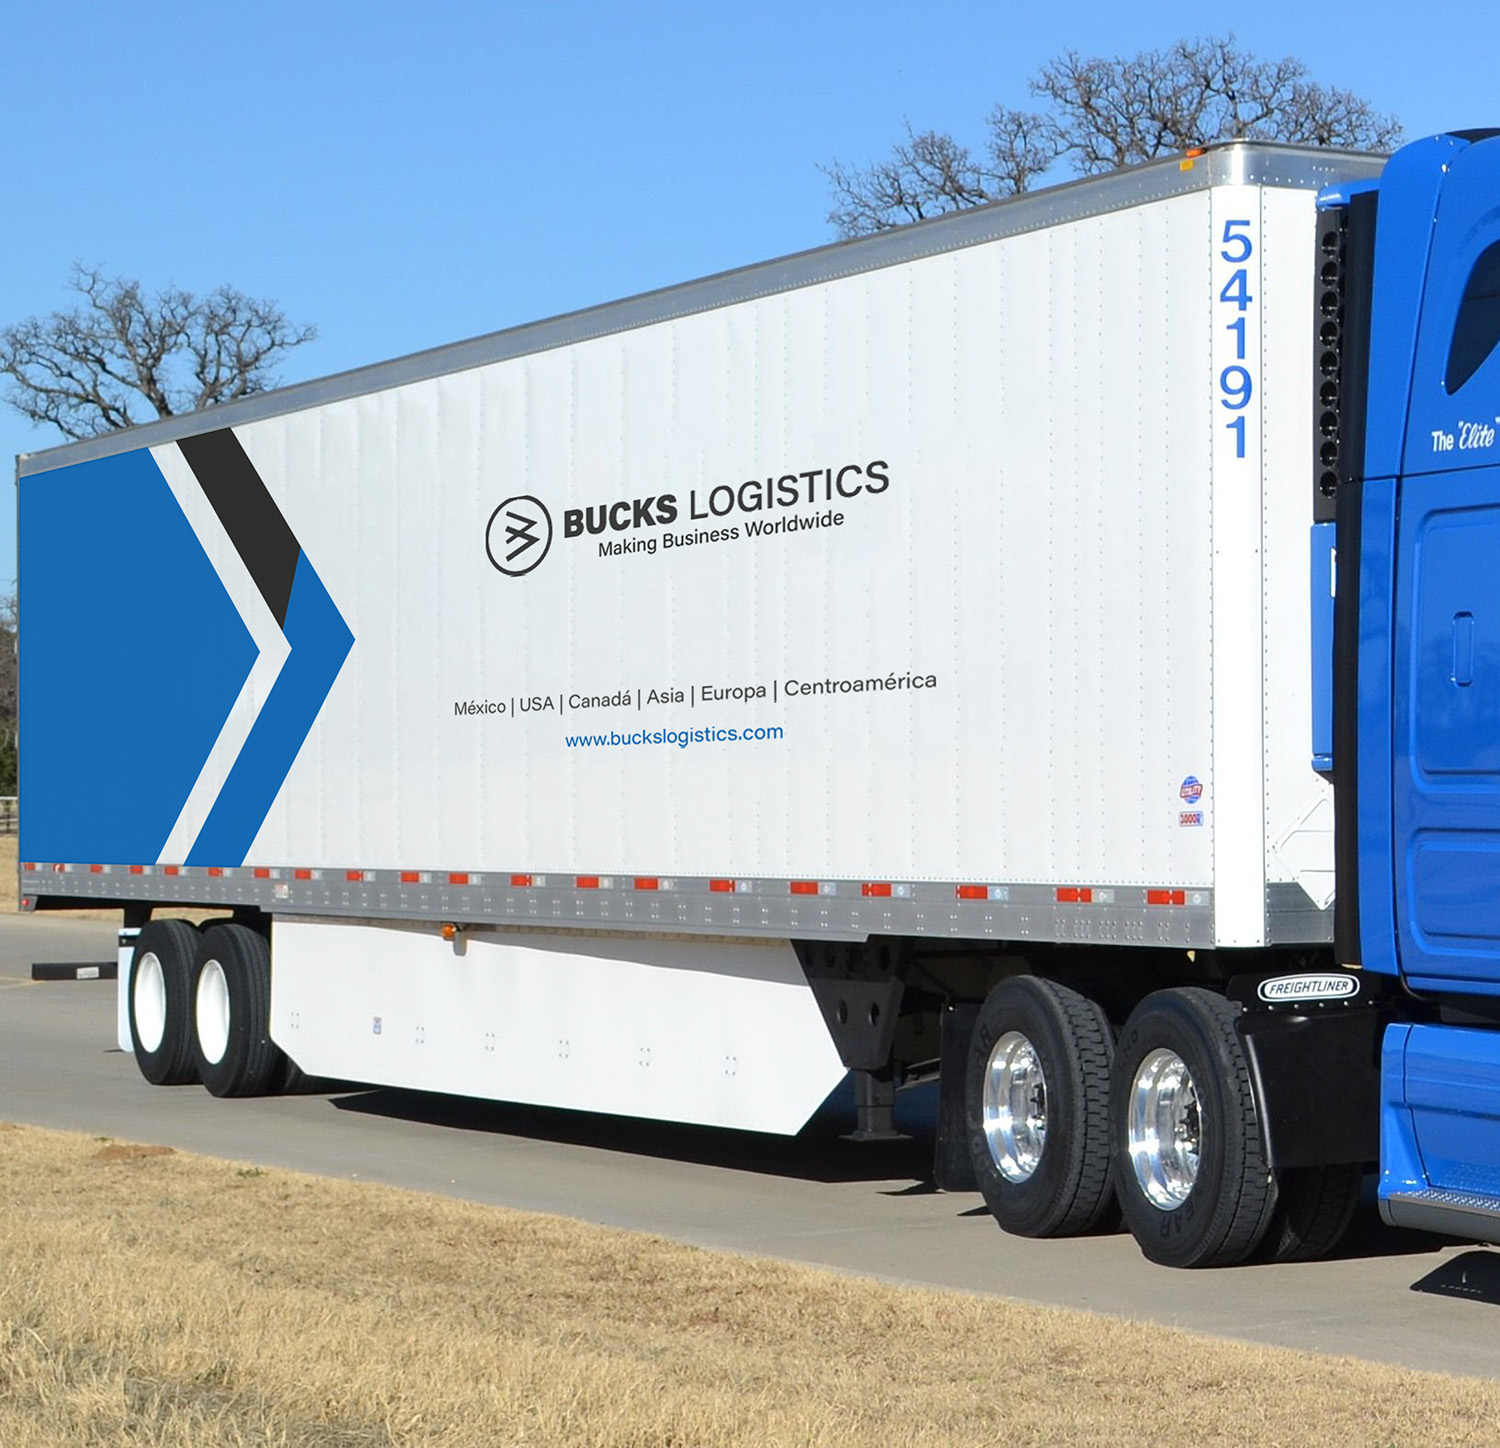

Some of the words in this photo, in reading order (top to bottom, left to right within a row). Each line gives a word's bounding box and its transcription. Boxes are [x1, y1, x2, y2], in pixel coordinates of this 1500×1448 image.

[1219, 219, 1254, 459] 54191
[1431, 430, 1454, 452] The
[563, 493, 678, 539] BUCKS
[690, 460, 890, 521] LOGISTICS
[598, 537, 657, 558] Making
[662, 527, 740, 549] Business
[744, 509, 845, 538] Worldwide
[454, 699, 507, 716] México
[519, 695, 555, 713] USA
[568, 689, 632, 709] Canadá
[646, 687, 685, 705] Asia
[701, 684, 767, 703] Europa
[784, 672, 938, 697] Centroamérica
[565, 726, 784, 748] www.buckslogistics.com
[1268, 980, 1350, 996] FREIGHTLINER
